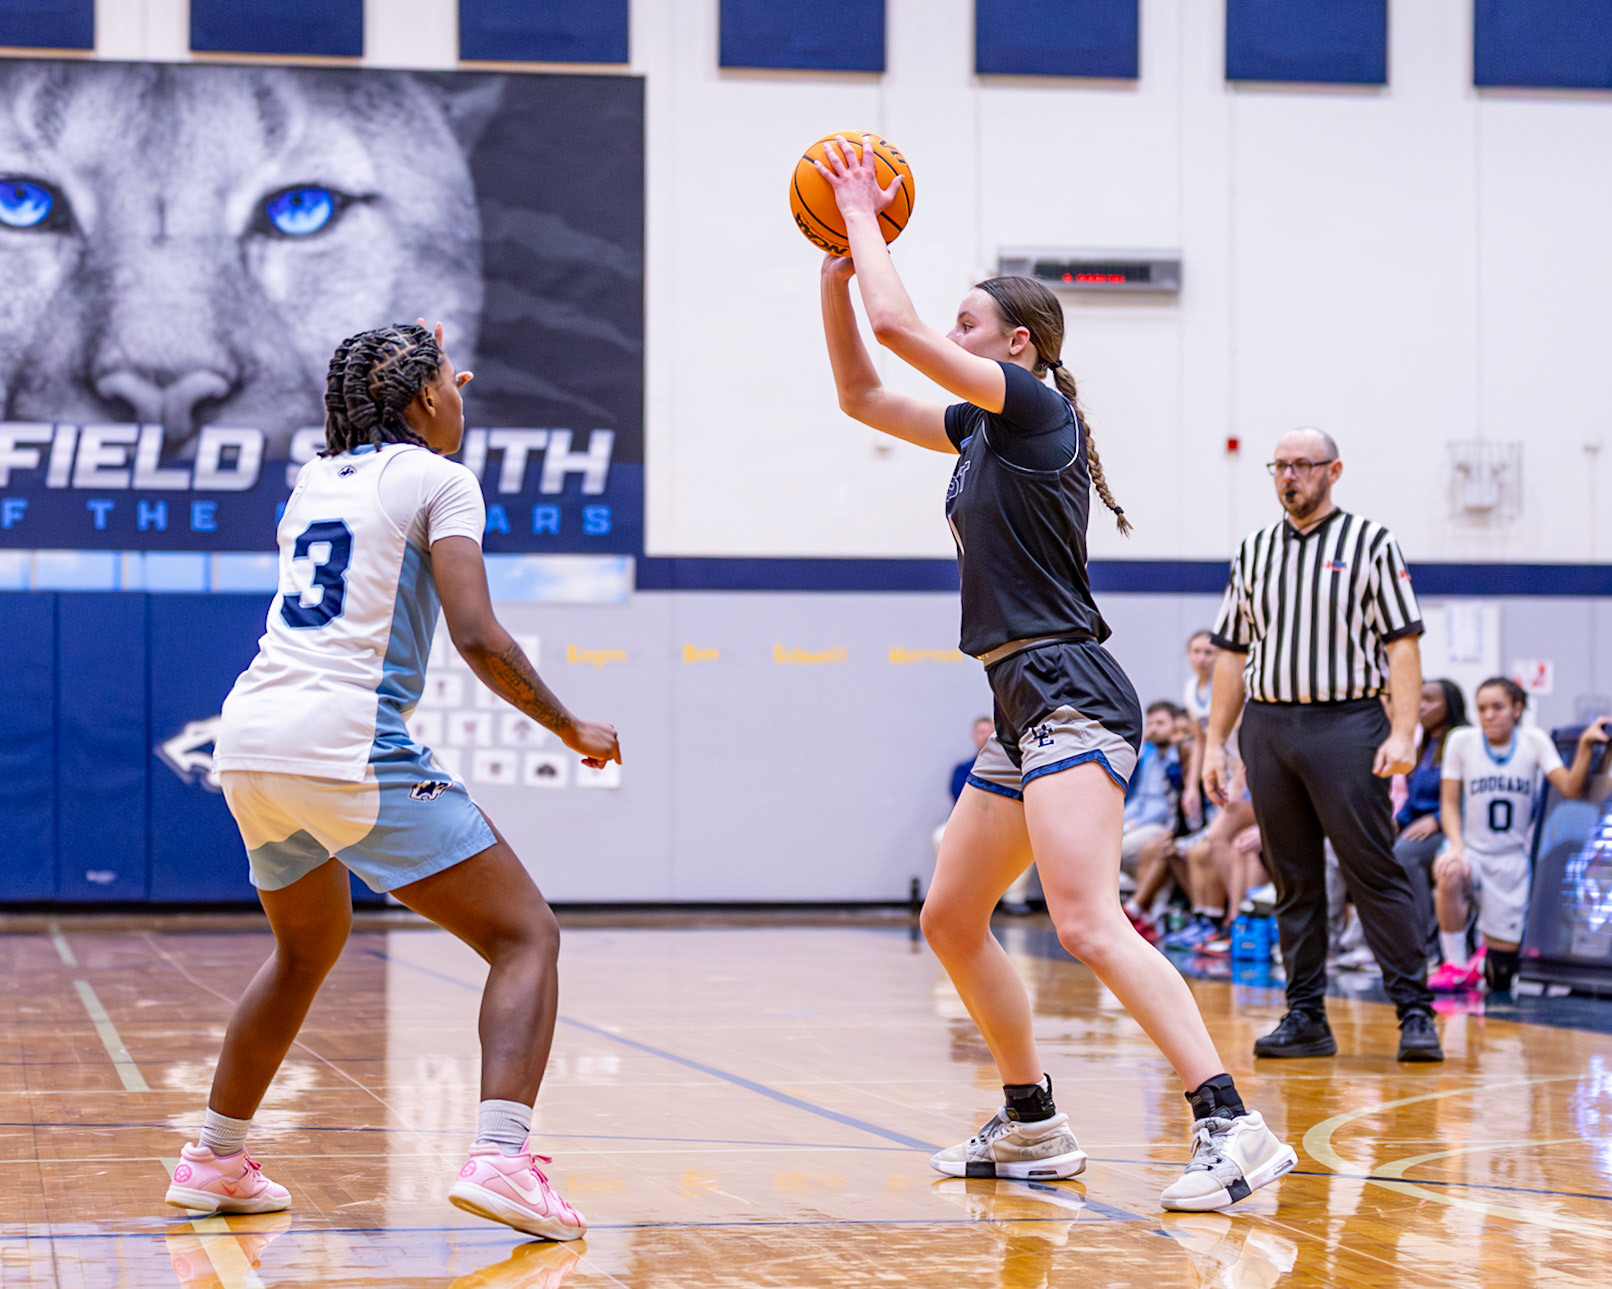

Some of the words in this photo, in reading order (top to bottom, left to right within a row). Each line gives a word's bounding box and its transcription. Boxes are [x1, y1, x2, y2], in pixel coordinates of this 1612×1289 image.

[0, 423, 264, 491] FIELD
[86, 499, 218, 531] THE
[279, 517, 355, 631] 3
[1488, 798, 1513, 833] 0
